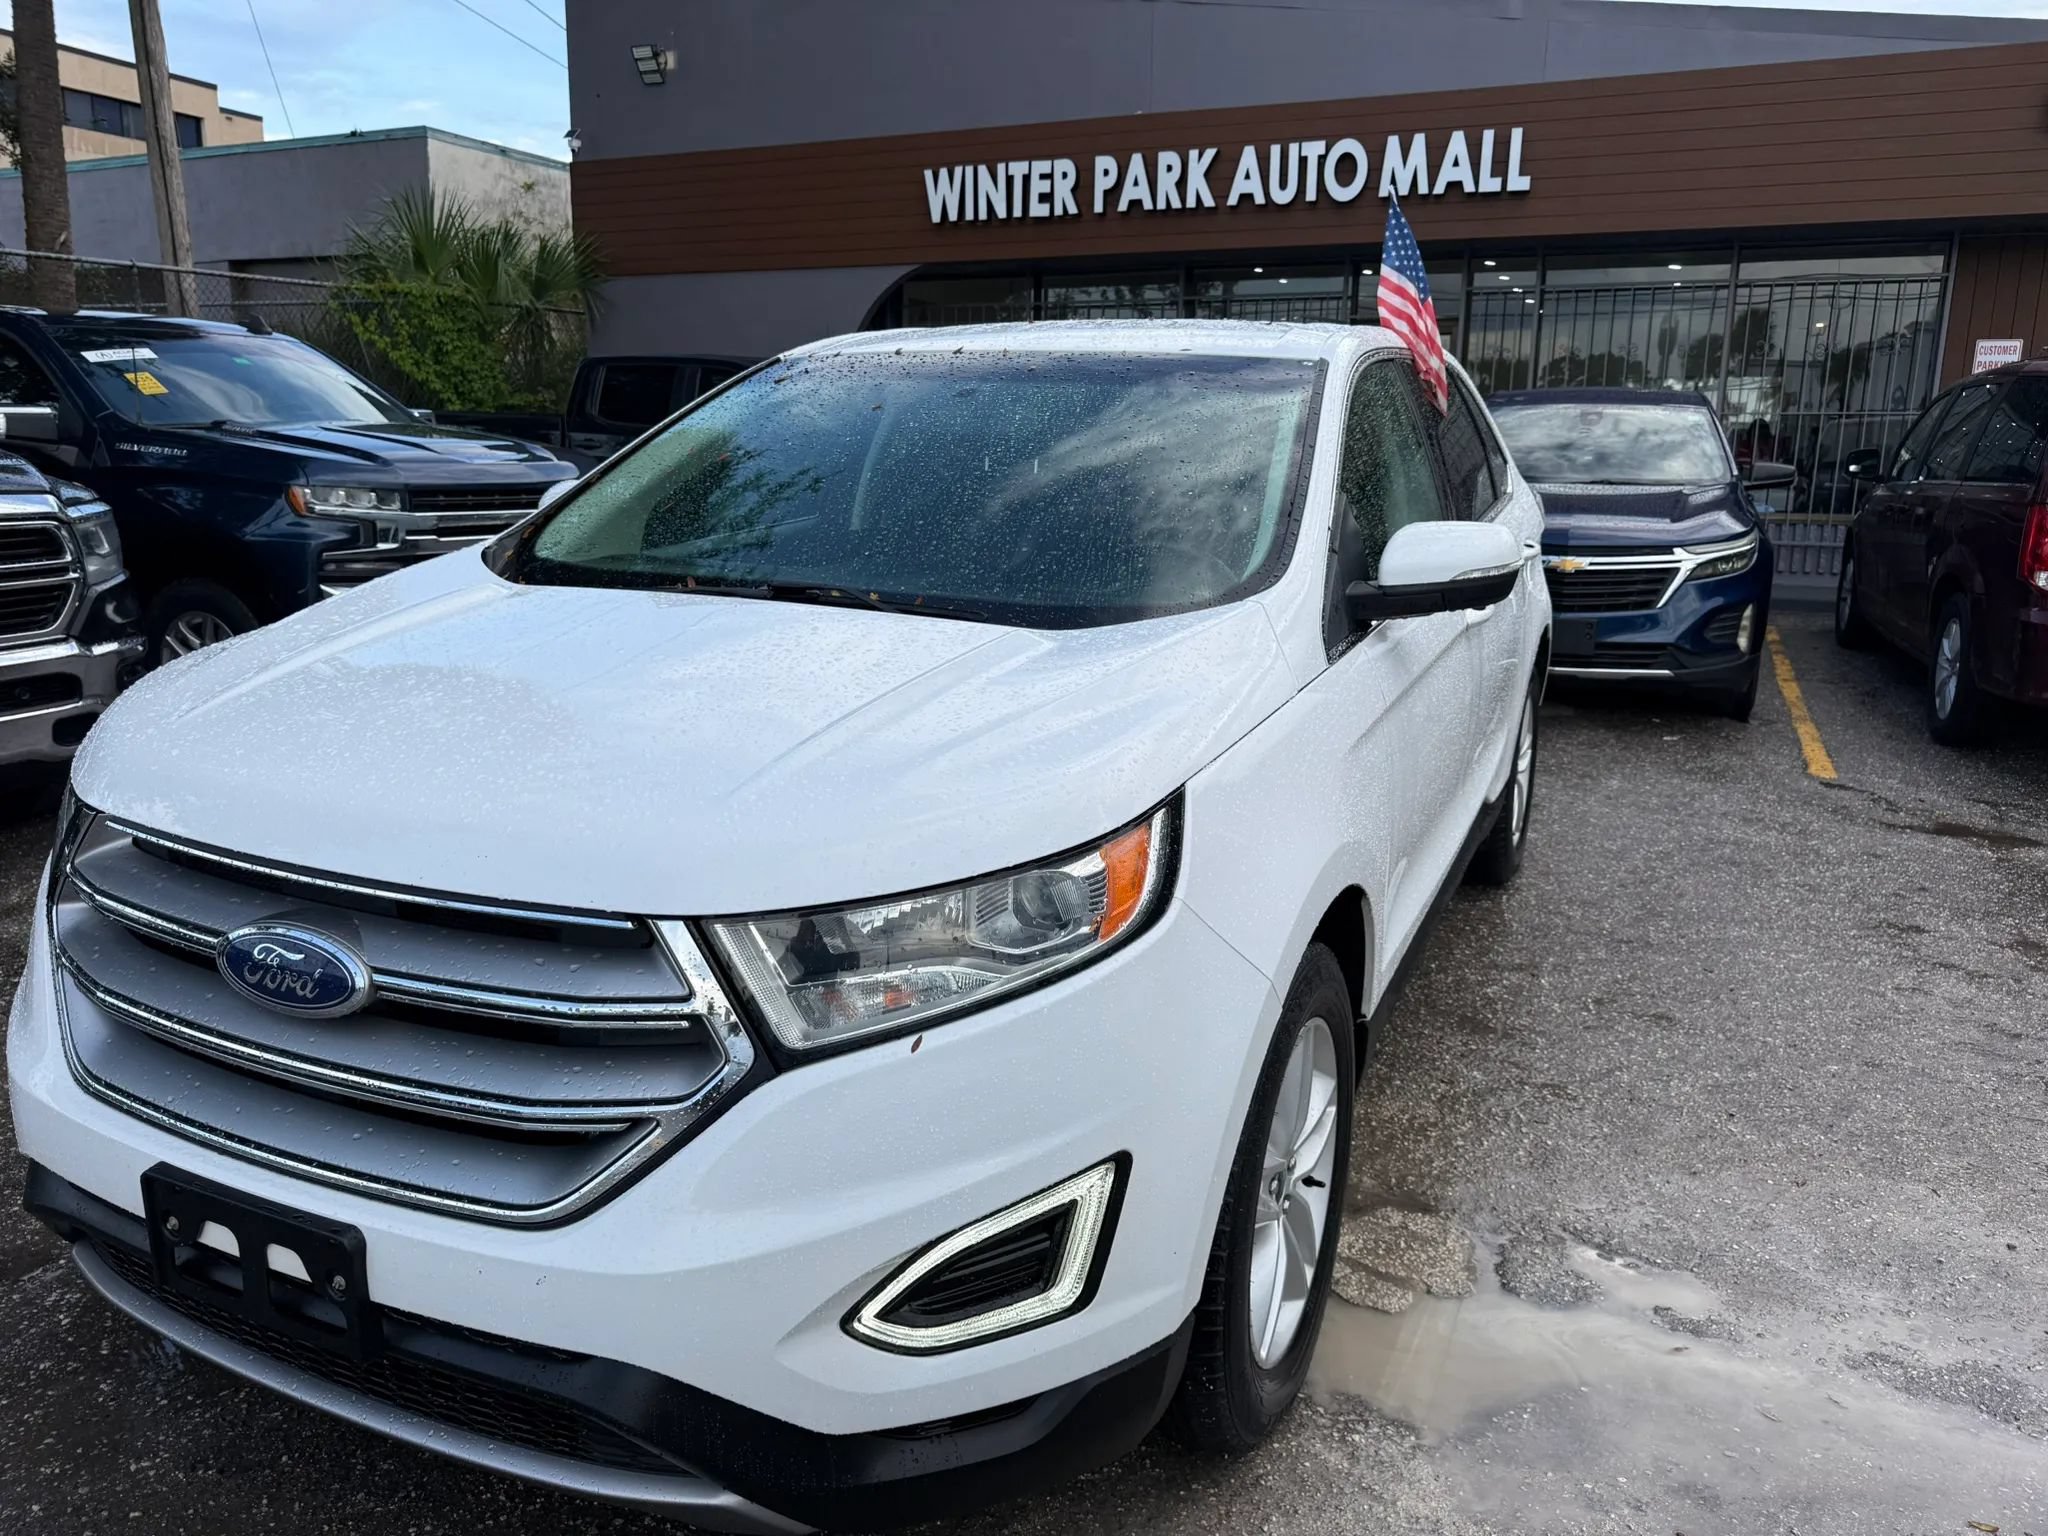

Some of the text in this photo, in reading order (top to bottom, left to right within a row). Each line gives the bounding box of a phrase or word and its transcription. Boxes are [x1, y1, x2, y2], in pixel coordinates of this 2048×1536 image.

[923, 127, 1531, 224] WINTER PARK AUTO MALL
[1979, 345, 2018, 356] CUSTOMER
[243, 943, 324, 999] Ford
